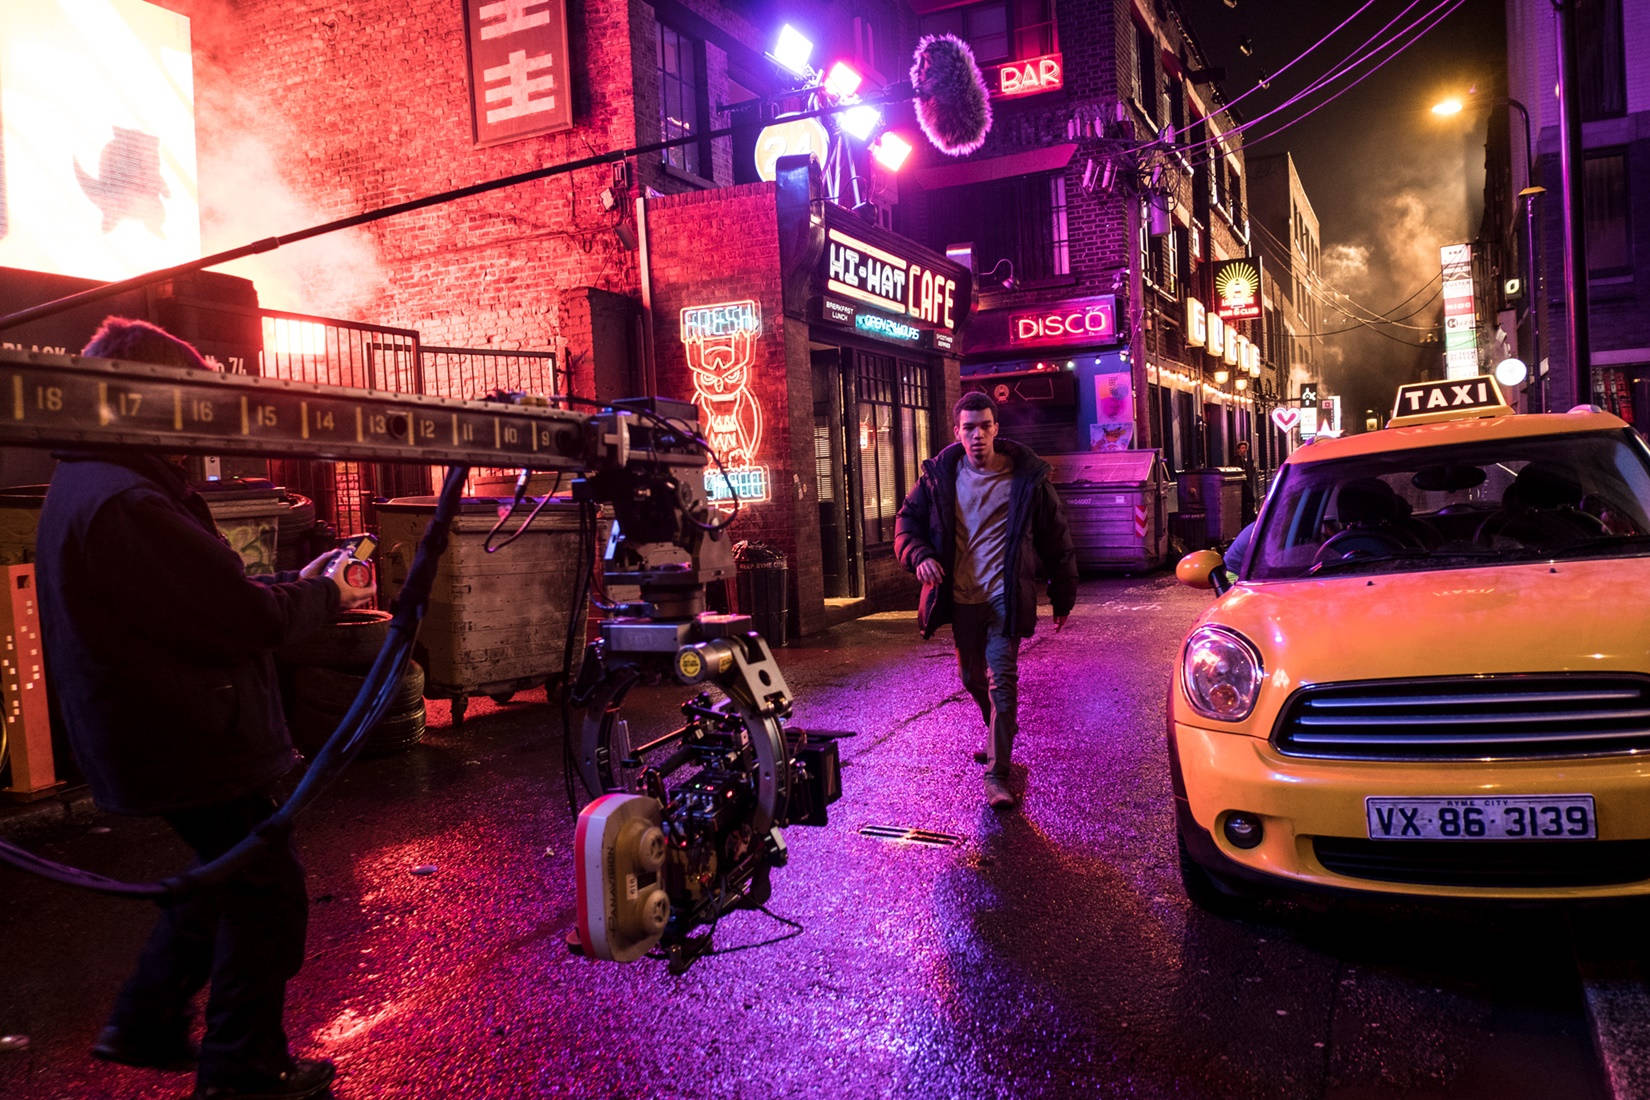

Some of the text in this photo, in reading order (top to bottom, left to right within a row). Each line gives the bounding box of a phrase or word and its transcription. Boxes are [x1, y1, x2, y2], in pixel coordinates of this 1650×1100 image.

[1001, 60, 1060, 93] BAR
[830, 243, 956, 329] HI-HAT CAFE
[684, 304, 754, 337] FRESH
[826, 301, 854, 314] BREAKFAST
[832, 311, 849, 321] LUNCH
[1018, 311, 1106, 338] DISCO
[1405, 383, 1487, 410] TAXI
[37, 386, 550, 446] 18 17 16 15 14 13 12 11 10 9
[1484, 799, 1509, 807] CITY
[1503, 806, 1589, 836] 3139
